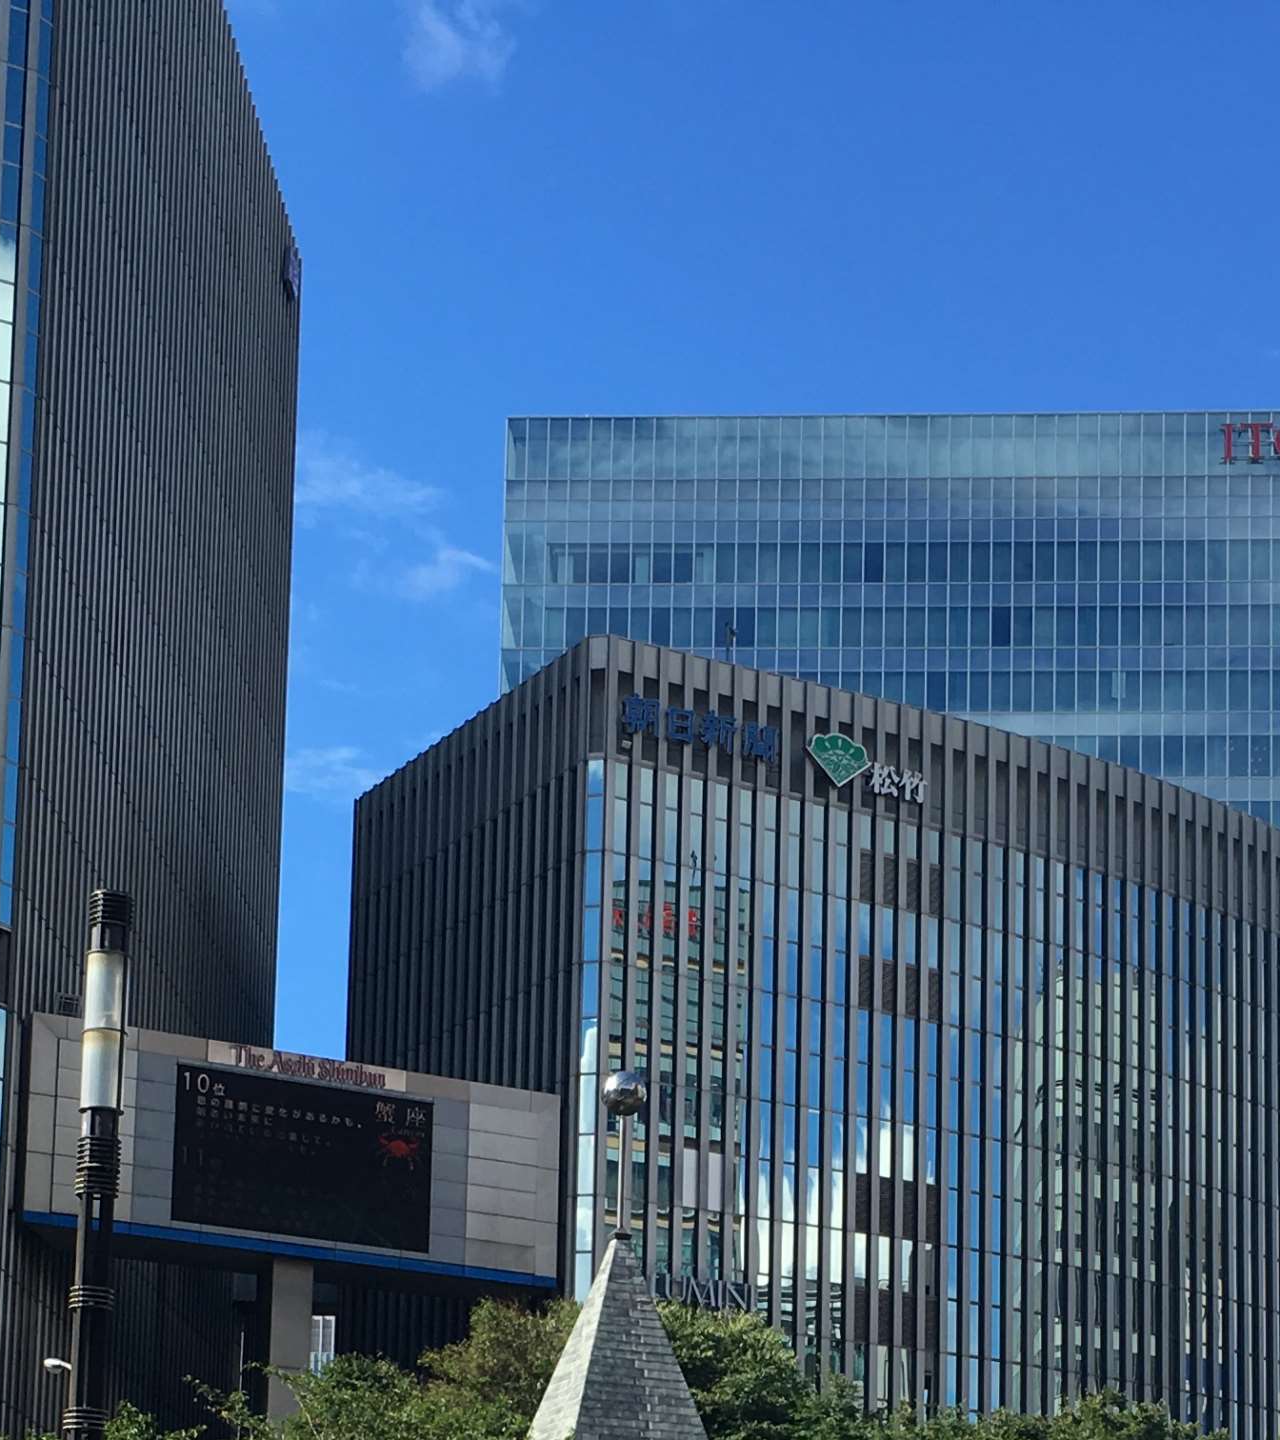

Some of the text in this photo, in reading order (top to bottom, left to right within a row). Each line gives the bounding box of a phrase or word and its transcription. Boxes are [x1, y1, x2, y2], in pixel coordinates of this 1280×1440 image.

[621, 692, 780, 765] 朝日新聞
[869, 761, 928, 804] 松竹
[230, 1045, 266, 1069] The
[269, 1052, 316, 1076] Asahi
